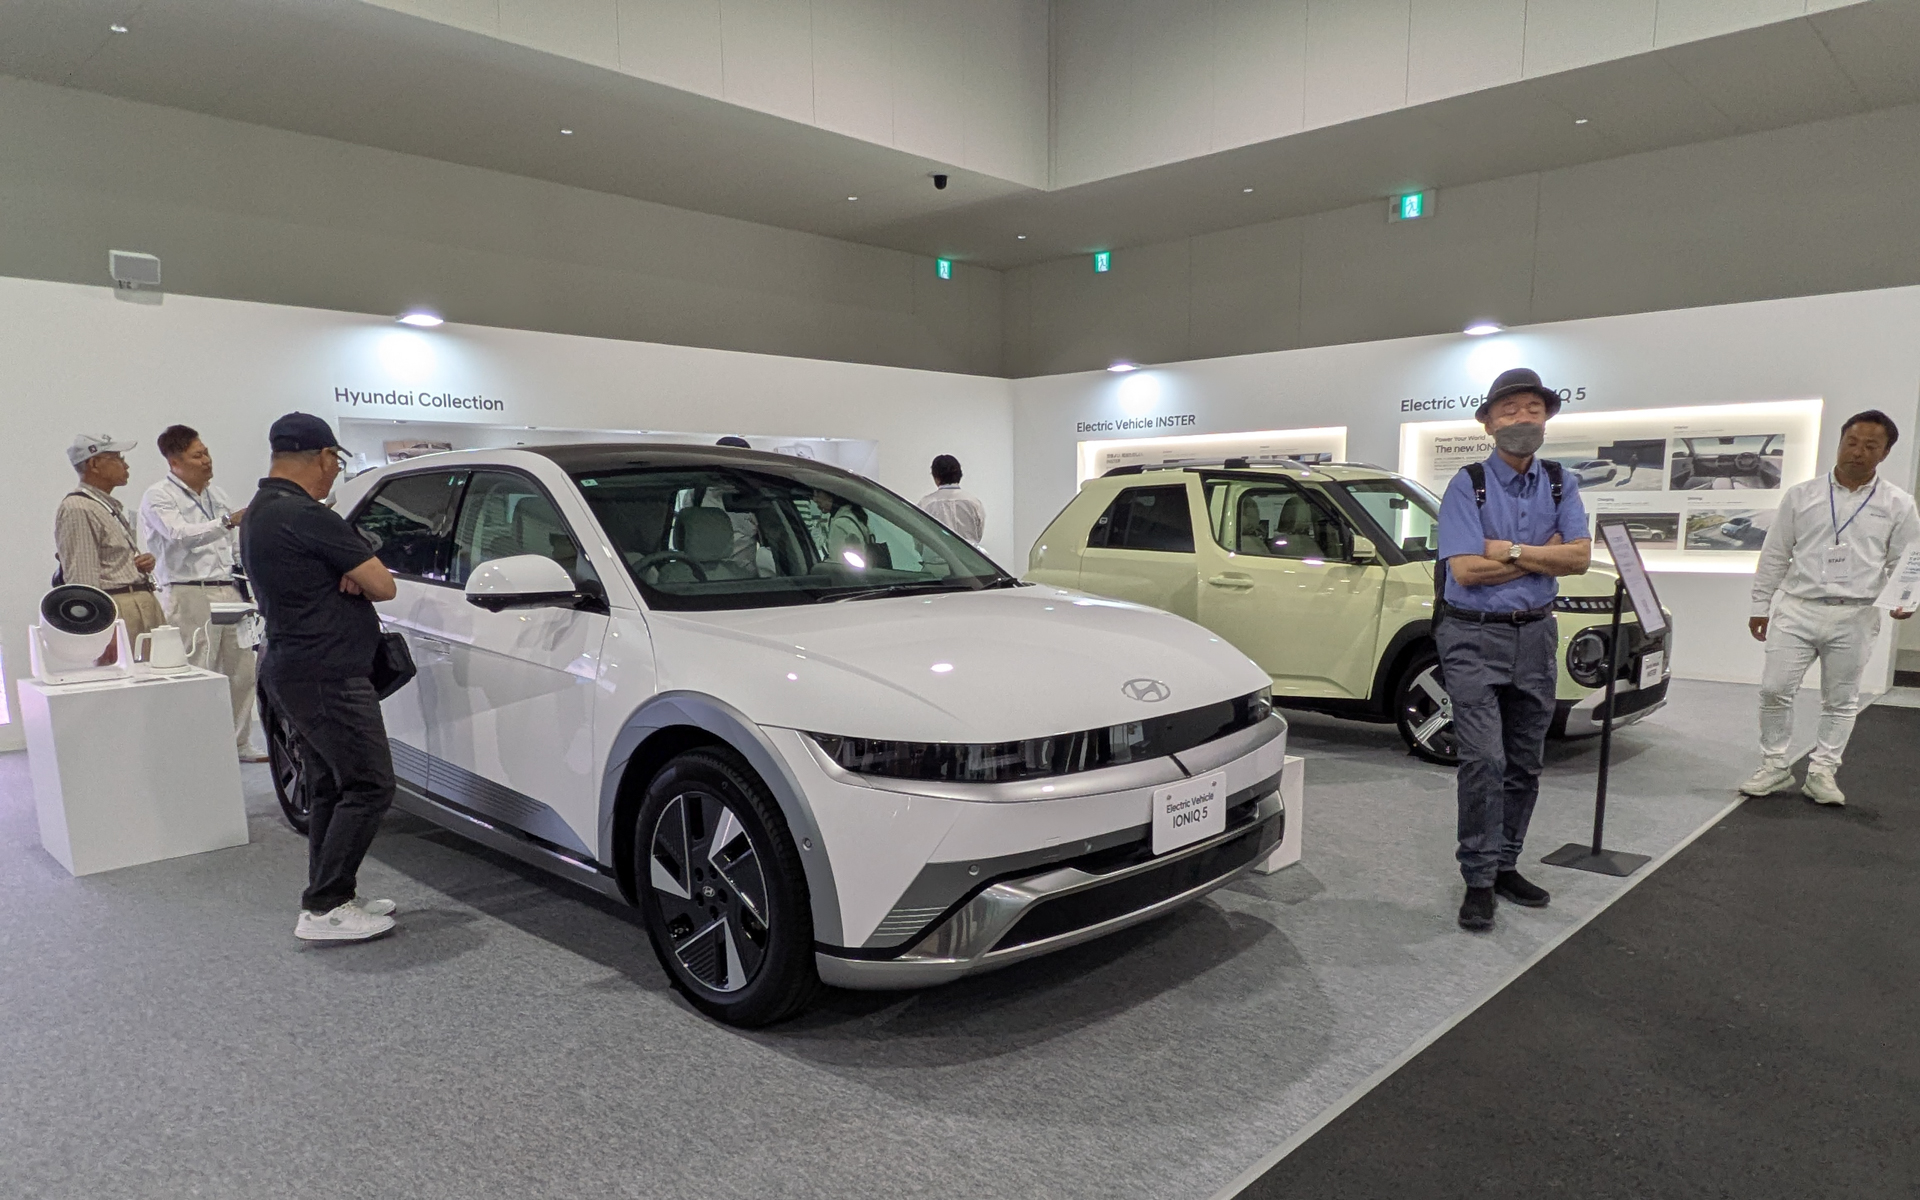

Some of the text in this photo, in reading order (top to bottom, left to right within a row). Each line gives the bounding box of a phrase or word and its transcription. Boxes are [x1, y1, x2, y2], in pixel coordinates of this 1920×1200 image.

[335, 387, 504, 411] Hyundai Collection
[1401, 396, 1456, 412] Electric
[1575, 387, 1586, 401] 5
[1076, 414, 1196, 433] Electric Vehicle INSTER
[1435, 445, 1453, 454] The
[1476, 443, 1495, 452] ION
[1166, 792, 1214, 814] Electric Vehicle
[1172, 806, 1208, 829] IONIQ 5
